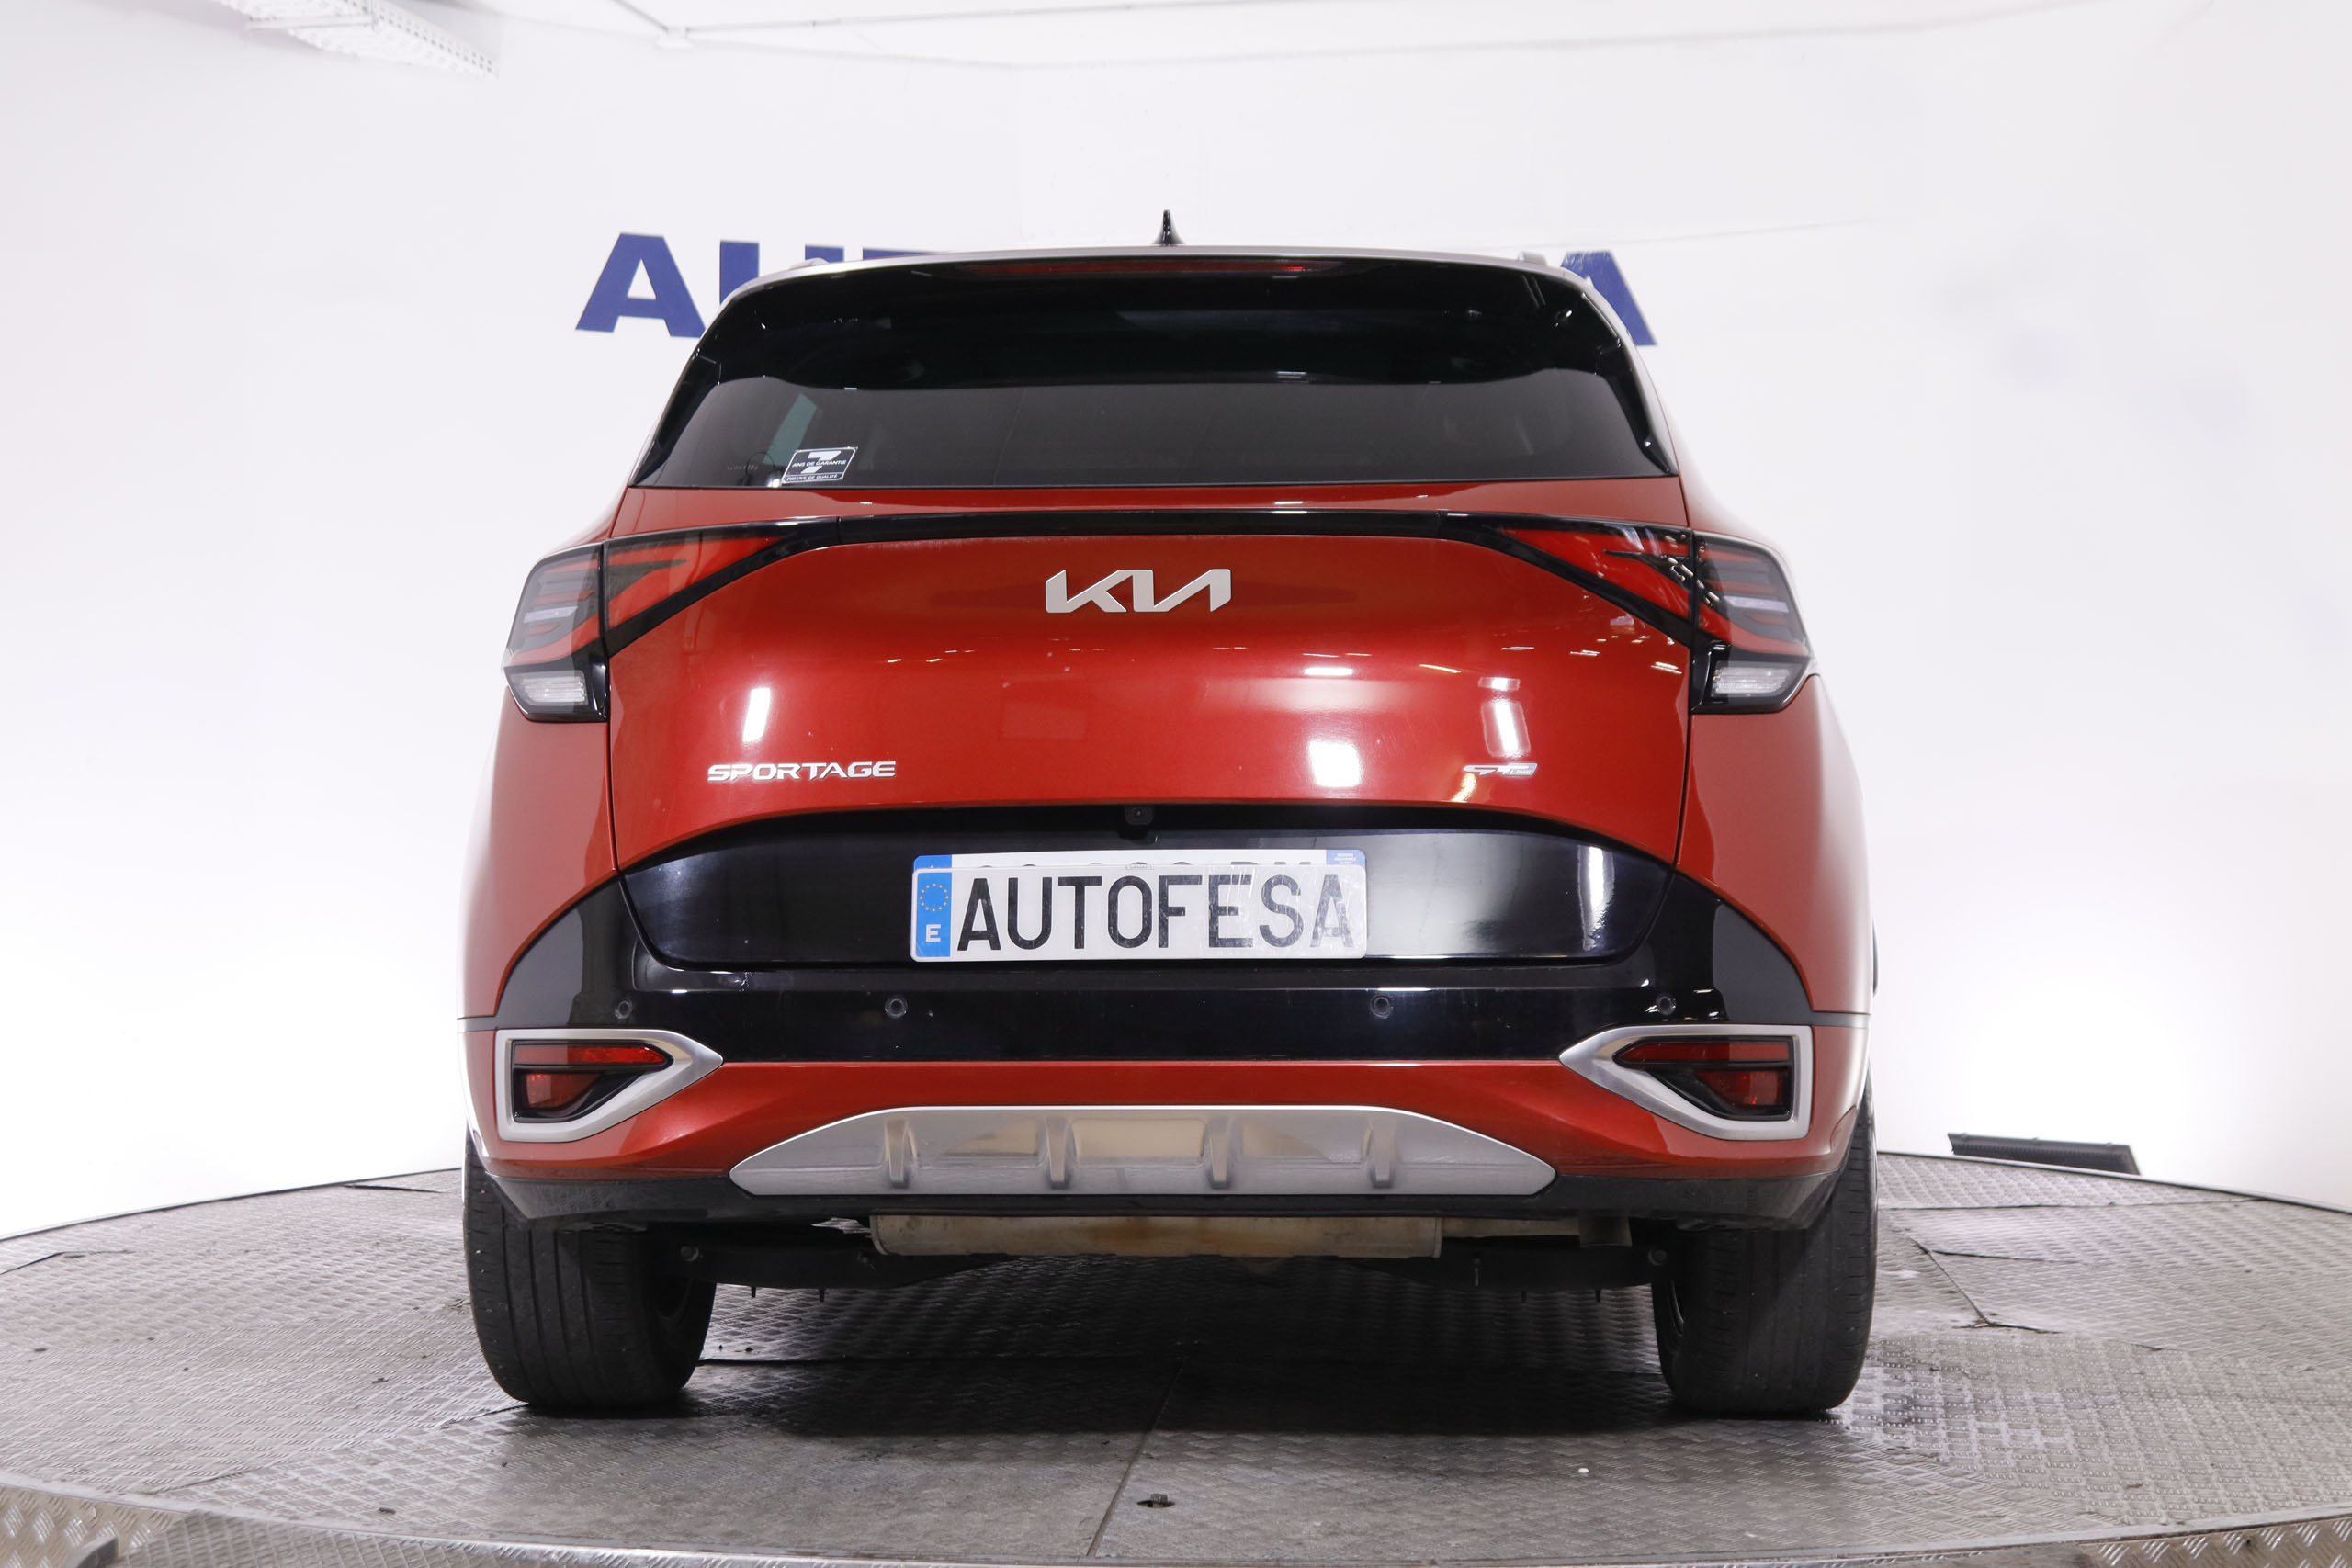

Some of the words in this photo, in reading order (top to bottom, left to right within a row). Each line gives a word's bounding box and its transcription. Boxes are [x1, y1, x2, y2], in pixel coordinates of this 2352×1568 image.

[800, 450, 842, 474] 7
[1046, 569, 1231, 613] KIA
[707, 761, 897, 781] SPORTAGE
[926, 924, 941, 942] E
[957, 874, 1353, 952] AUTOFESA
